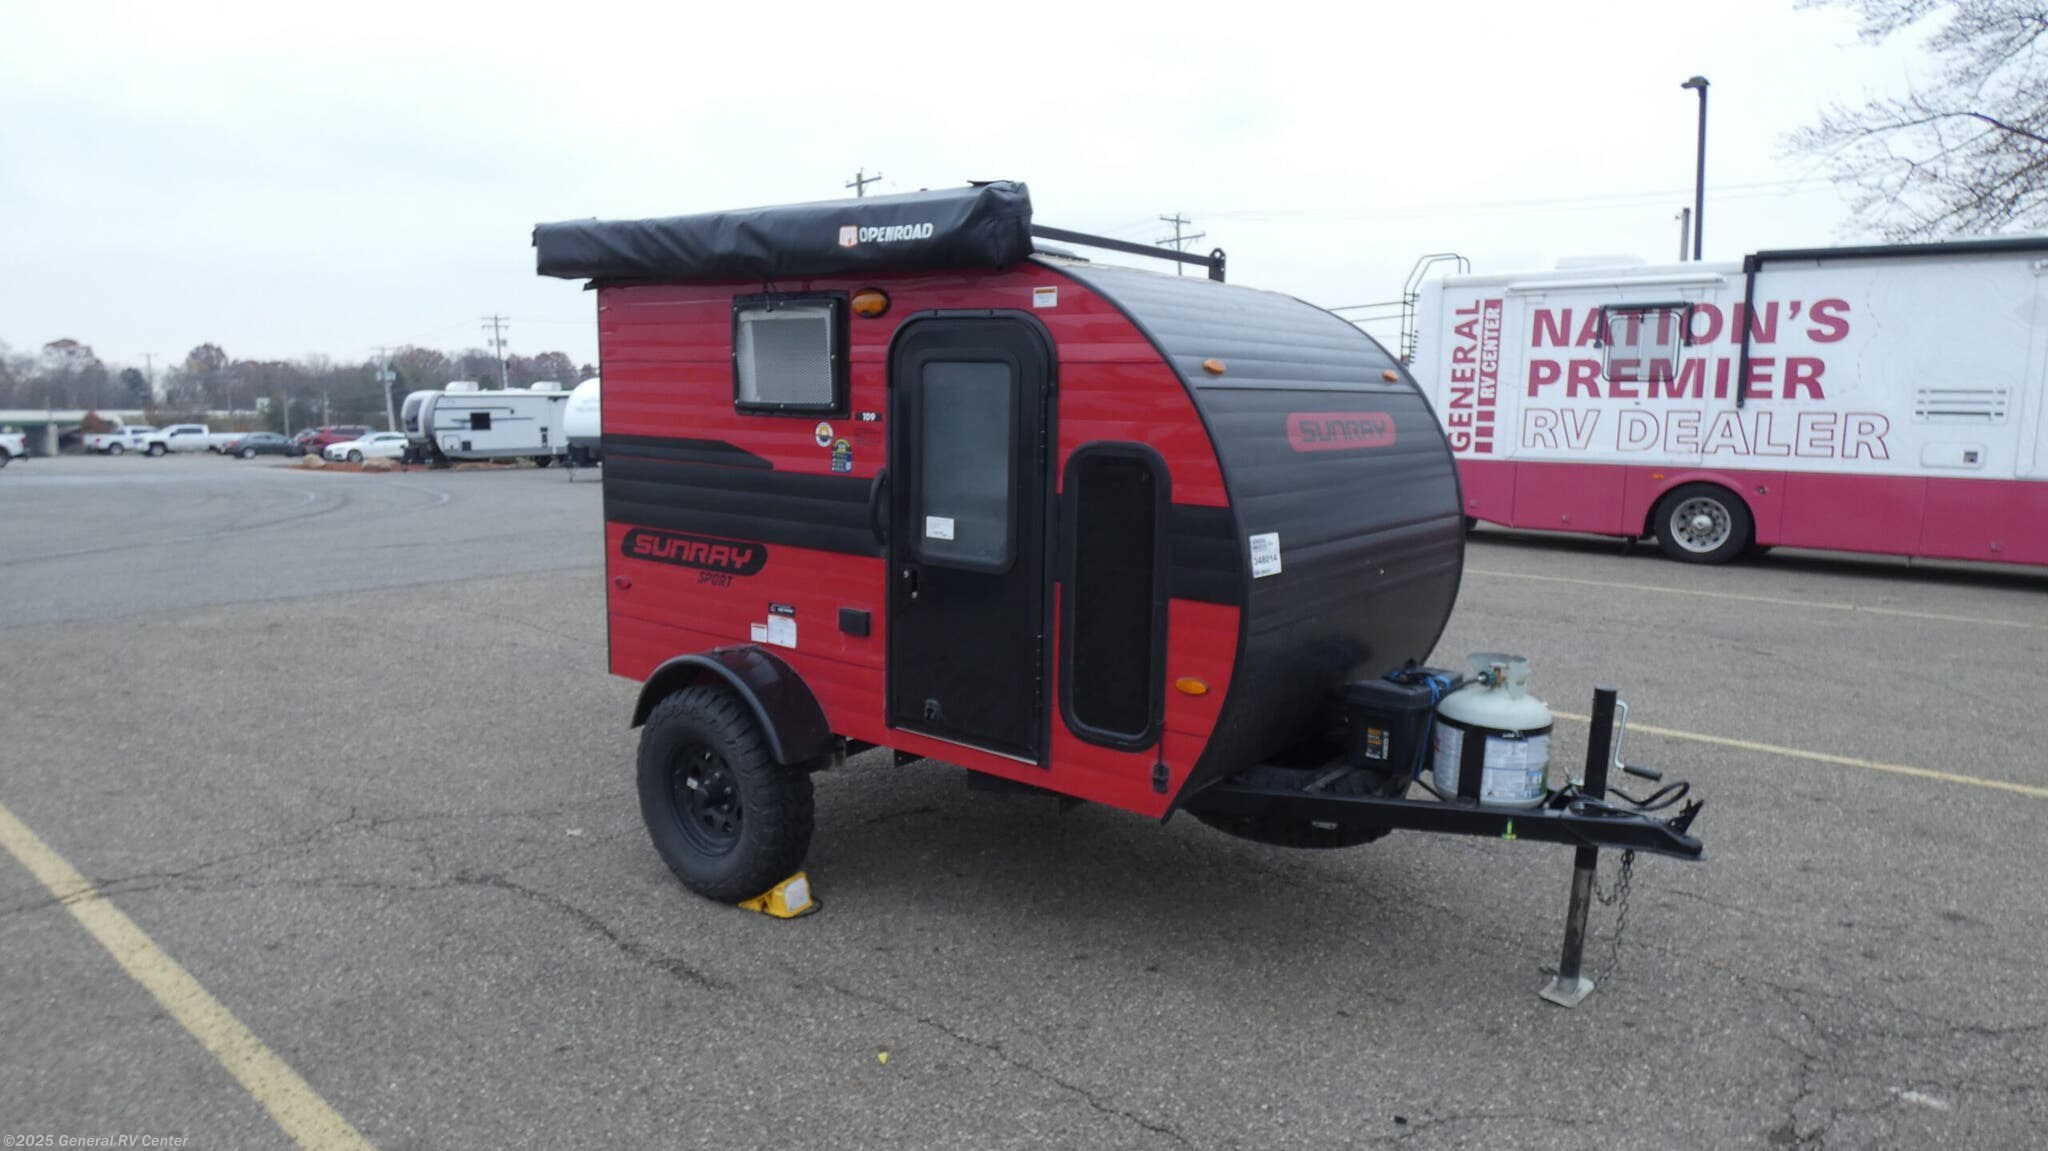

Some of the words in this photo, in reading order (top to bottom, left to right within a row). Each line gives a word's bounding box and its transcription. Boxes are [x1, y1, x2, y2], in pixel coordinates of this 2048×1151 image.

[859, 222, 934, 243] OPENROAD
[1481, 307, 1501, 372] CENTER
[1531, 297, 1851, 348] NATION'S
[1447, 299, 1480, 452] GENERAL
[1479, 376, 1496, 399] RV
[1527, 356, 1826, 400] PREMIER
[862, 412, 877, 422] 109
[1299, 419, 1385, 443] SUNRAY
[1522, 408, 1600, 451] RV
[1616, 410, 1891, 460] DEALER
[633, 533, 753, 569] SUNRAY
[697, 571, 734, 588] SPORT
